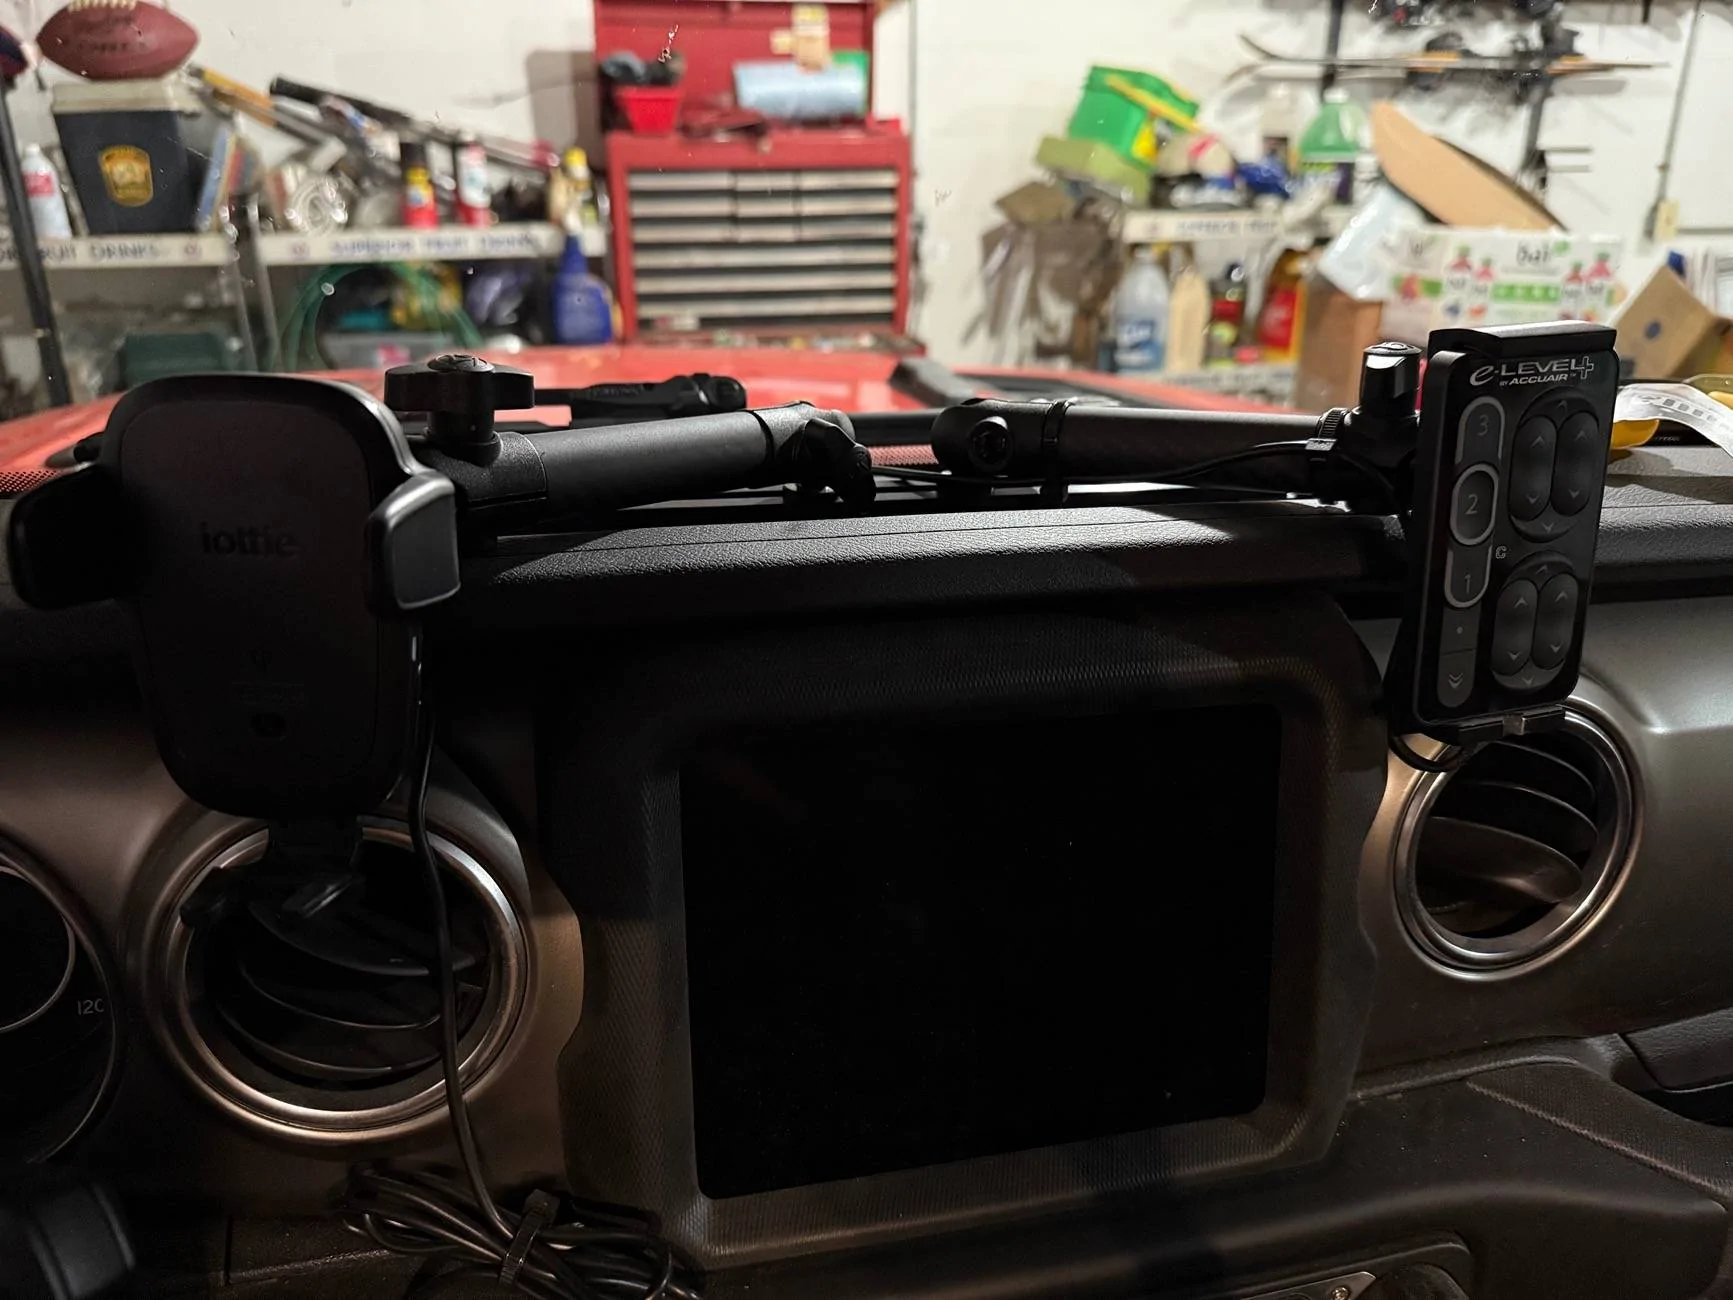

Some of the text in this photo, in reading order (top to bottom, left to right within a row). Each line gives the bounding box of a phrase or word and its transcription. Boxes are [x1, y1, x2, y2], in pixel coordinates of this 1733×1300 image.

[1477, 415, 1490, 436] 3
[1465, 493, 1479, 514] 2
[1463, 573, 1470, 595] 1
